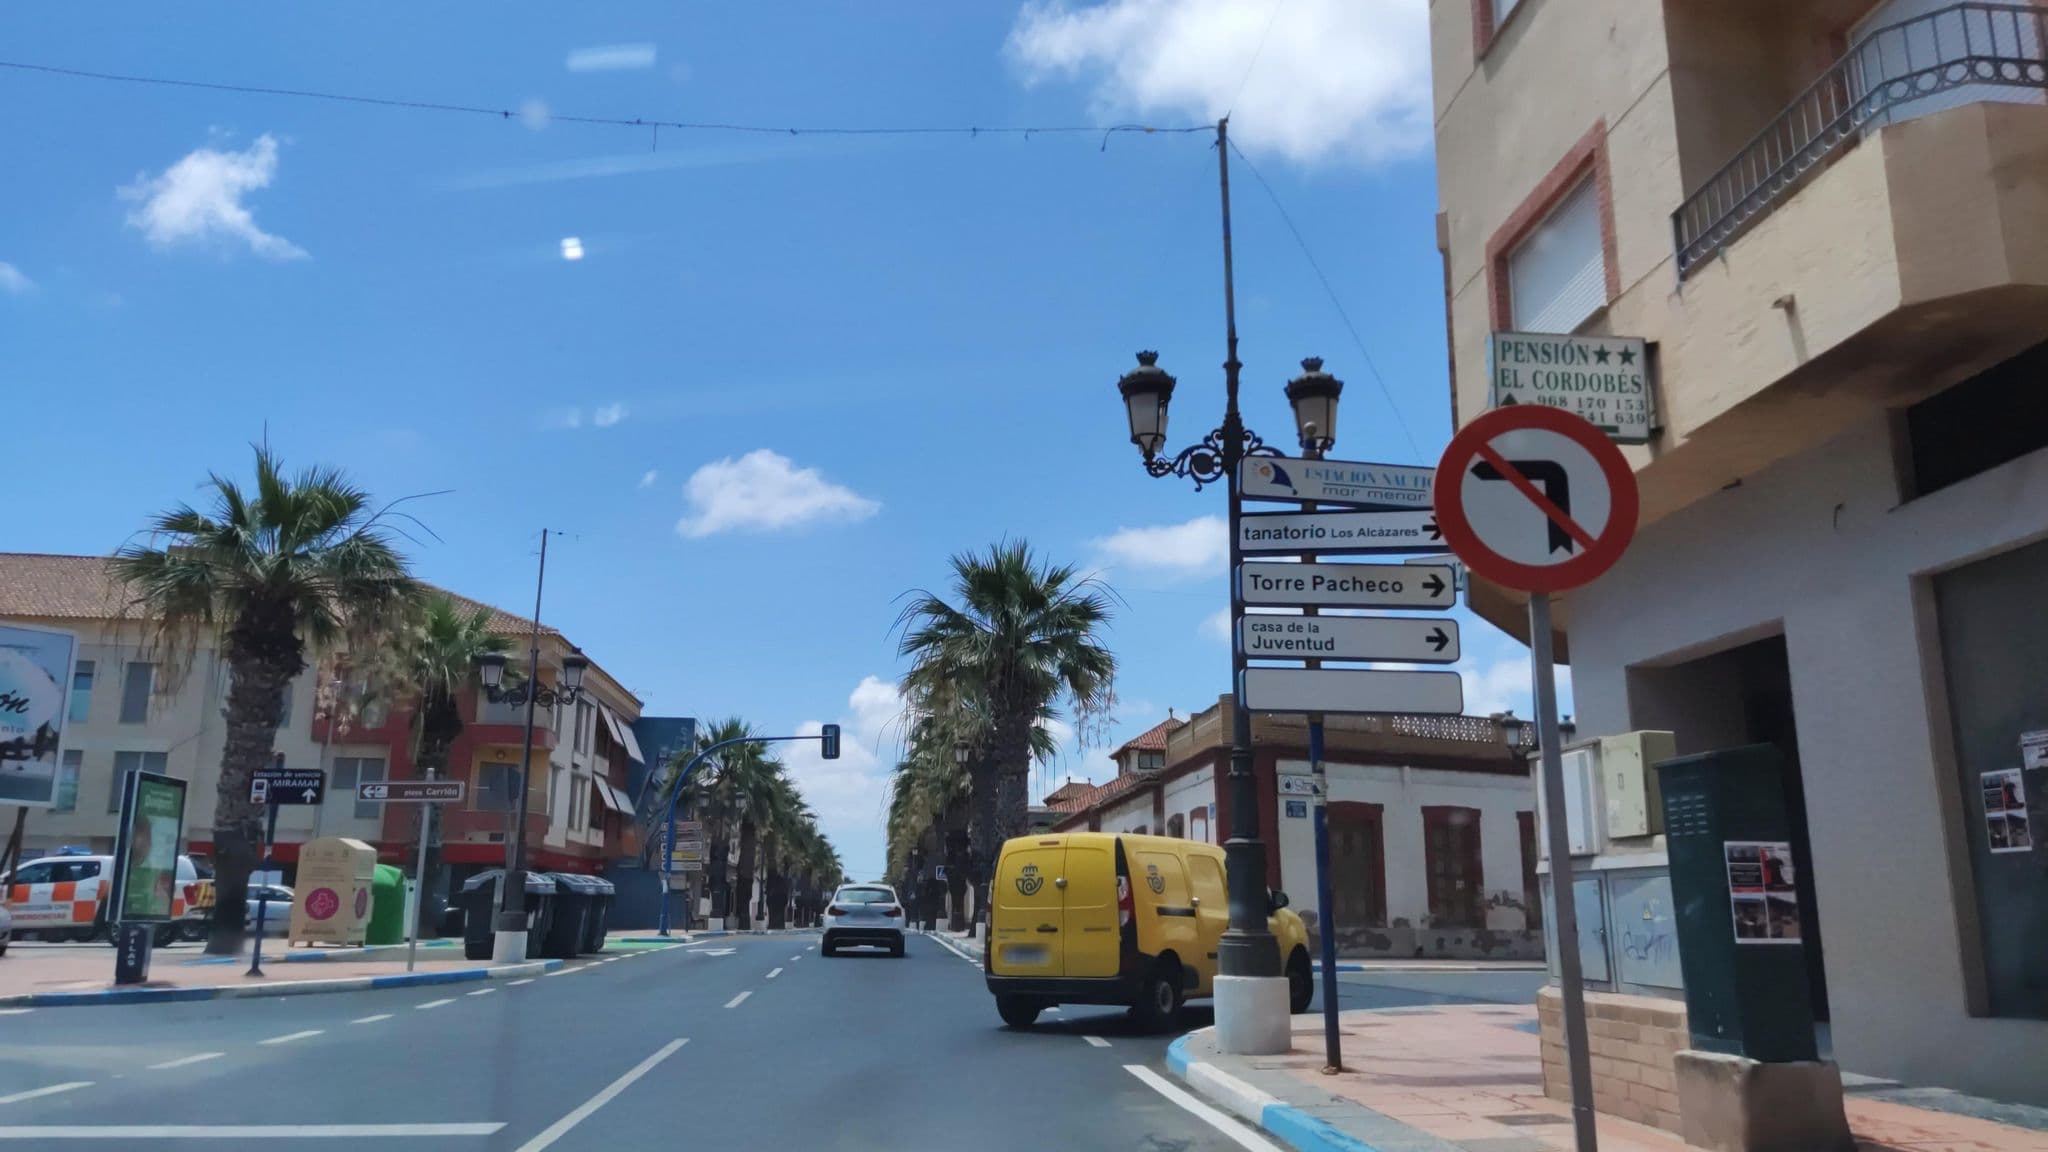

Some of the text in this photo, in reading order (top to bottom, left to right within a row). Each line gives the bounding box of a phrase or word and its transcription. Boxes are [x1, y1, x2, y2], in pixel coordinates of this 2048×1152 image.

[1501, 339, 1589, 366] PENSIÓN
[1501, 368, 1642, 394] EL CORDOBÉS
[1578, 397, 1606, 409] 170
[1616, 400, 1644, 411] 153
[1615, 413, 1646, 425] 639
[1322, 486, 1426, 501] mar menor
[1244, 524, 1419, 541] tanatorio Los Alcázares
[1250, 574, 1404, 593] Torre Pacheco
[1251, 622, 1320, 634] casa de la
[1252, 635, 1335, 651] Juventud
[272, 778, 320, 788] MIRAMAR
[426, 787, 458, 796] Carrión
